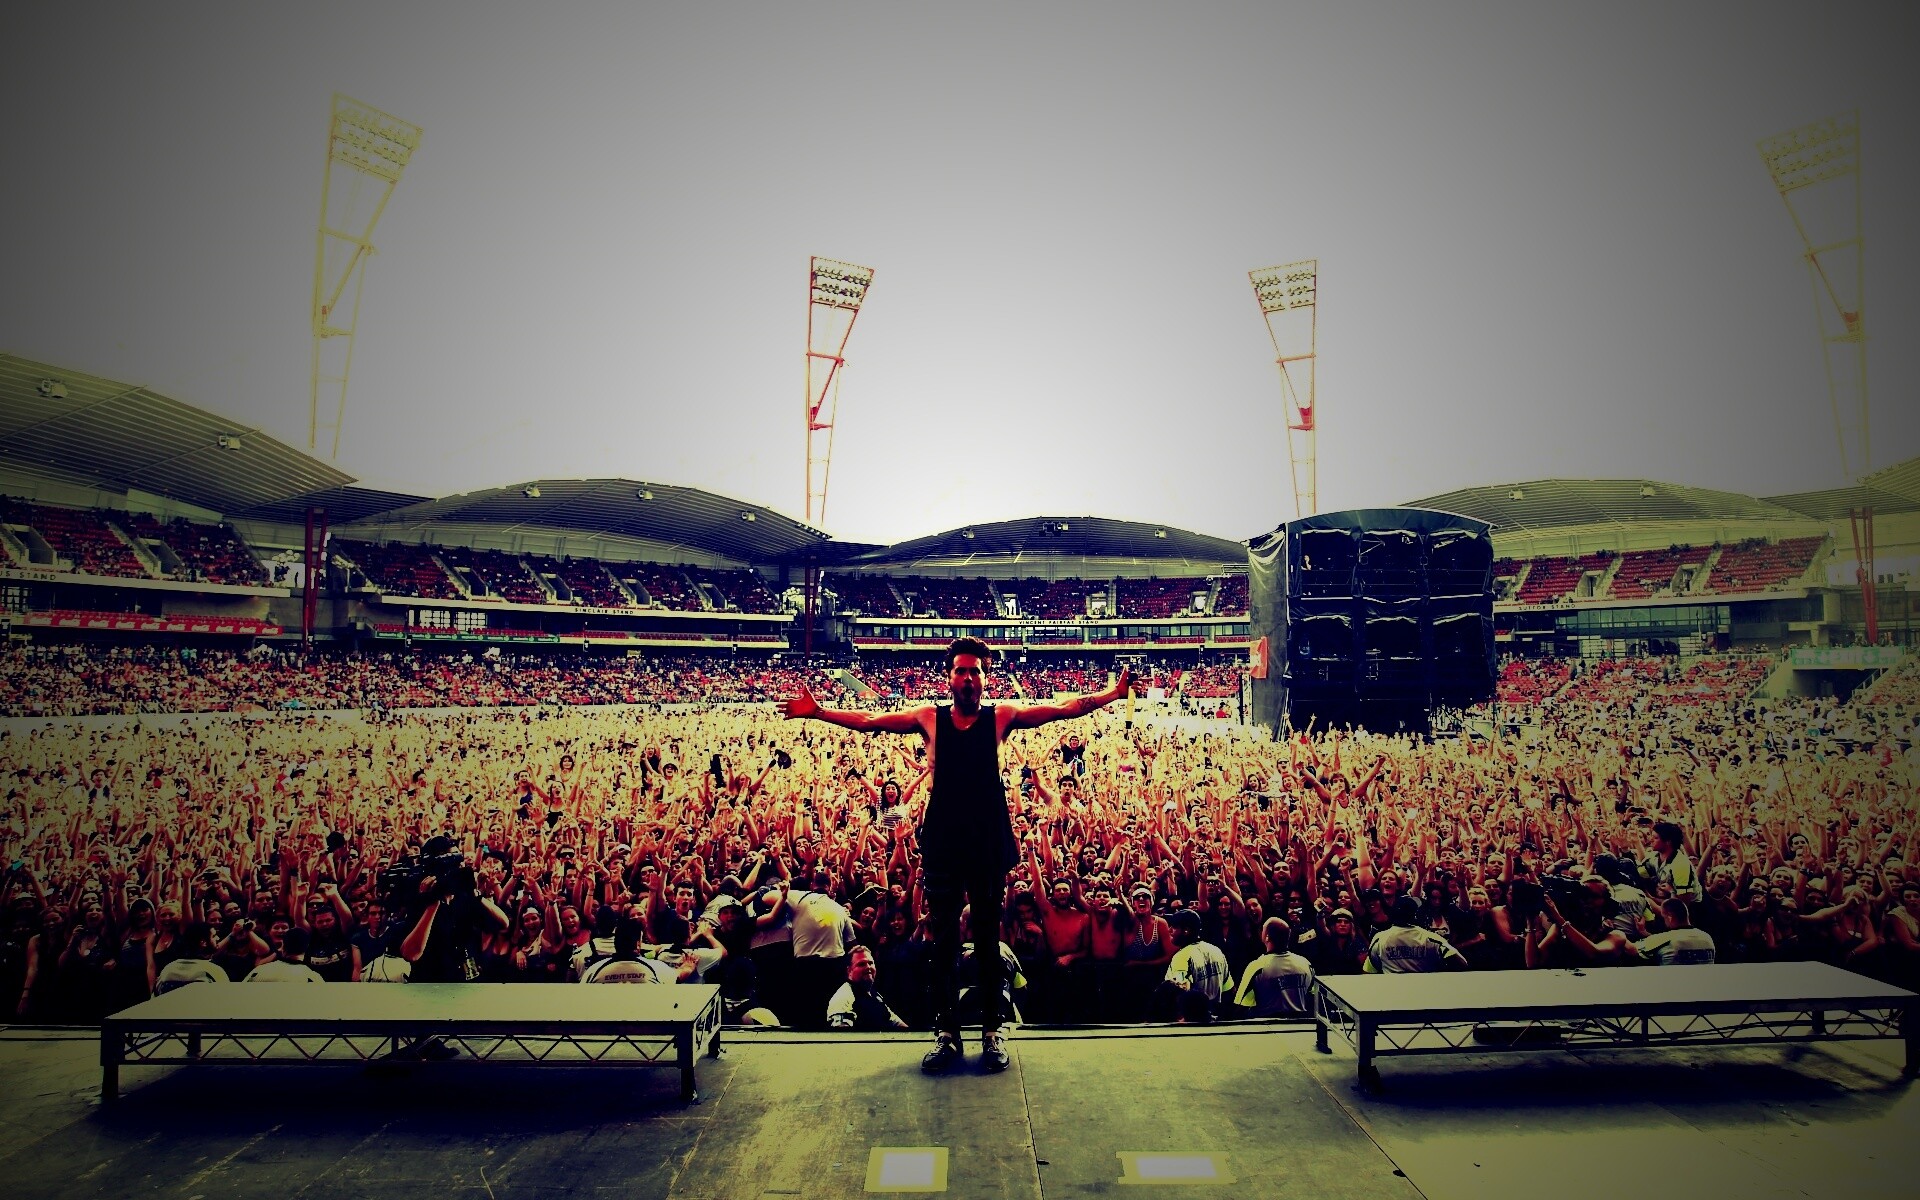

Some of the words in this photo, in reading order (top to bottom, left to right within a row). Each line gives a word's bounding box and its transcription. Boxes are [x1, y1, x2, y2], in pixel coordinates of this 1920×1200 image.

[19, 571, 57, 581] STAND
[604, 973, 626, 981] EVENT
[627, 972, 646, 980] STAFF
